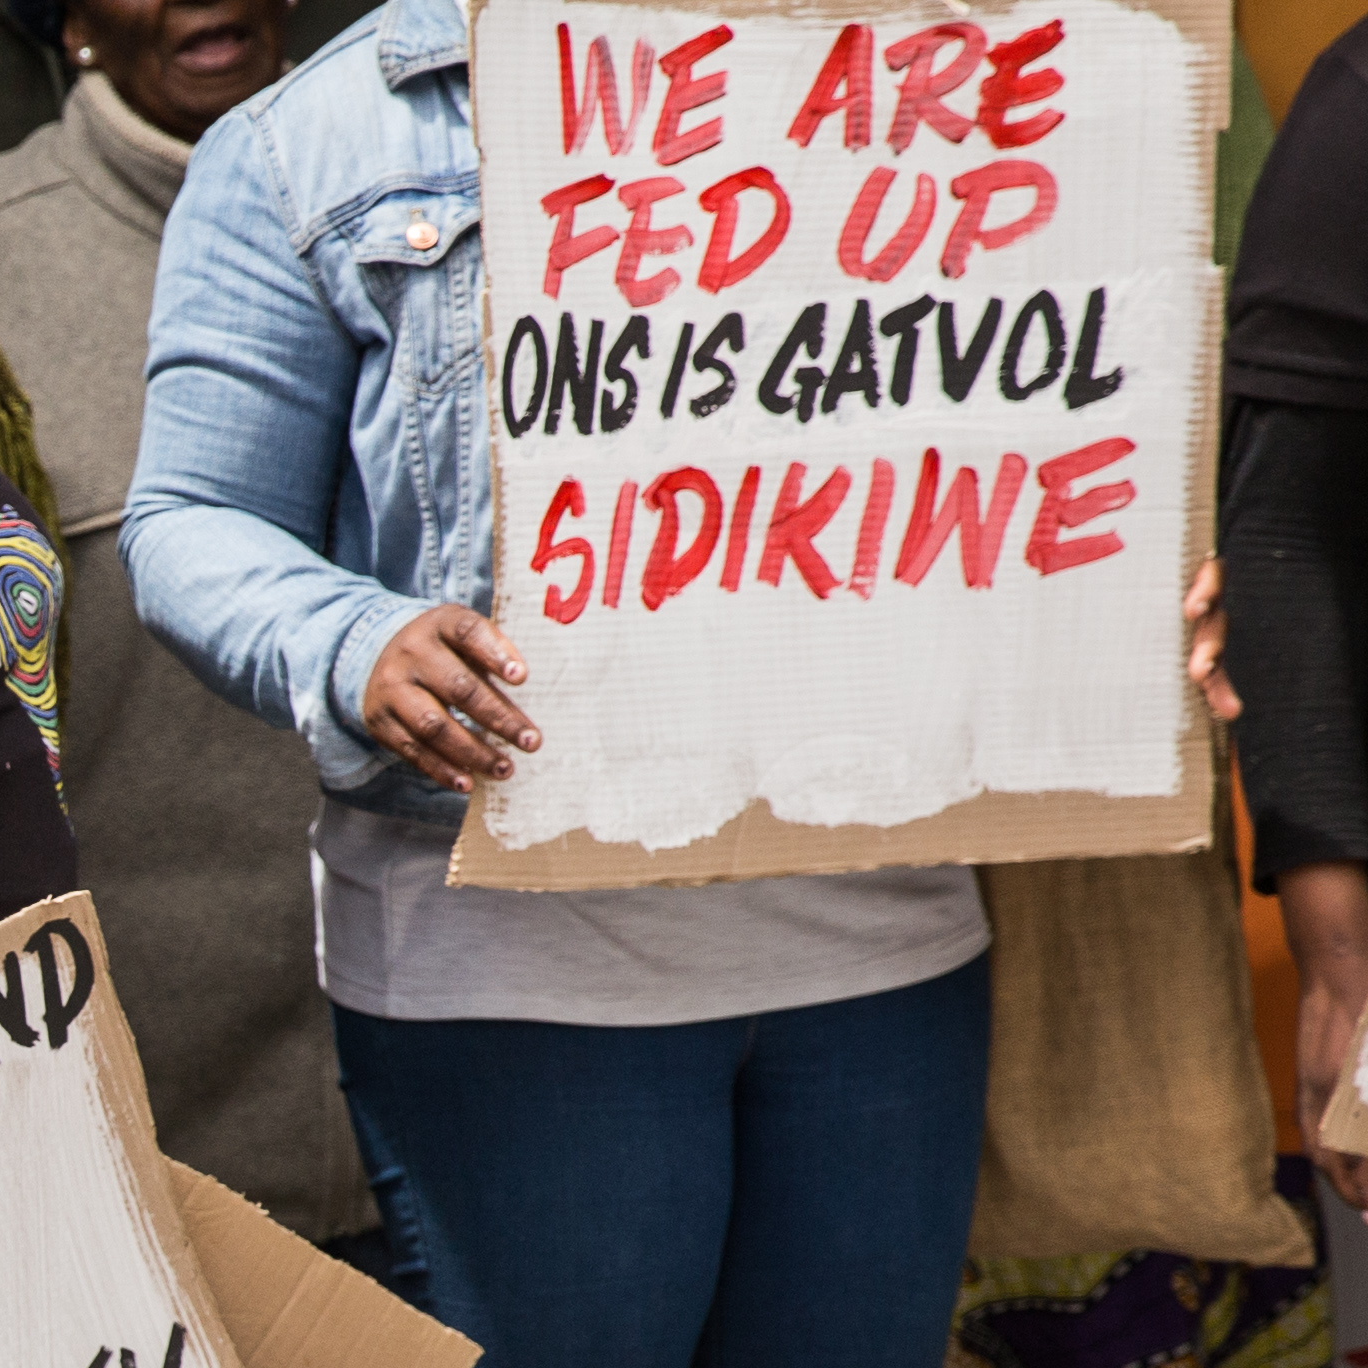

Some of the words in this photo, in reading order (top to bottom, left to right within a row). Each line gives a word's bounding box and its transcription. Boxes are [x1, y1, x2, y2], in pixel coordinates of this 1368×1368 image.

[555, 22, 735, 167] WE
[786, 18, 1066, 155] ARE
[539, 165, 792, 308] FED
[836, 159, 1059, 283] UP
[501, 313, 651, 440] ONS
[660, 313, 744, 419] IS
[757, 287, 1124, 424] GATVOL
[529, 436, 1138, 626] SIDIKIWE
